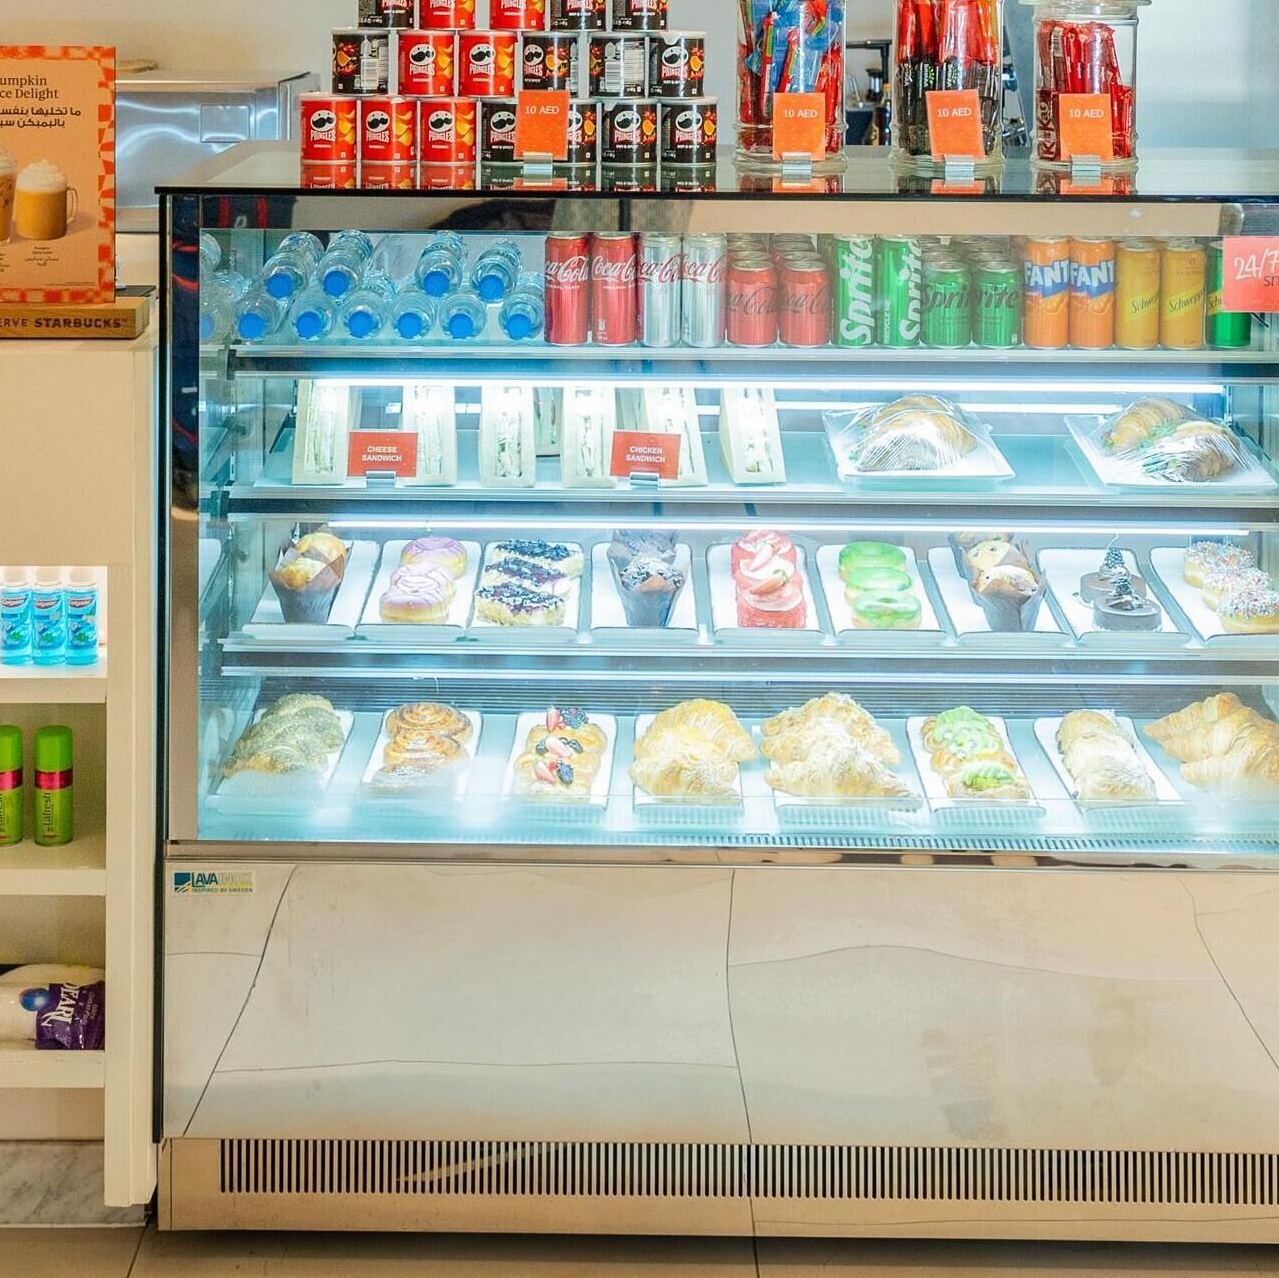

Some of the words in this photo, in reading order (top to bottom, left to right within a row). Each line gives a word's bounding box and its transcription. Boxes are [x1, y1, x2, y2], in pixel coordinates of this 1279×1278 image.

[14, 86, 59, 102] Delight
[525, 105, 537, 115] 10
[538, 105, 561, 115] AED
[783, 108, 795, 118] 10
[796, 108, 818, 119] AED
[937, 108, 950, 118] 10
[951, 107, 972, 117] AED
[1069, 108, 1082, 119] 10
[1082, 108, 1105, 119] AED
[34, 317, 122, 329] STARBUCKS
[367, 445, 398, 454] CHEESE
[629, 445, 663, 455] CHICKEN
[361, 454, 402, 462] SANDWICH
[625, 453, 666, 463] SANDWICH
